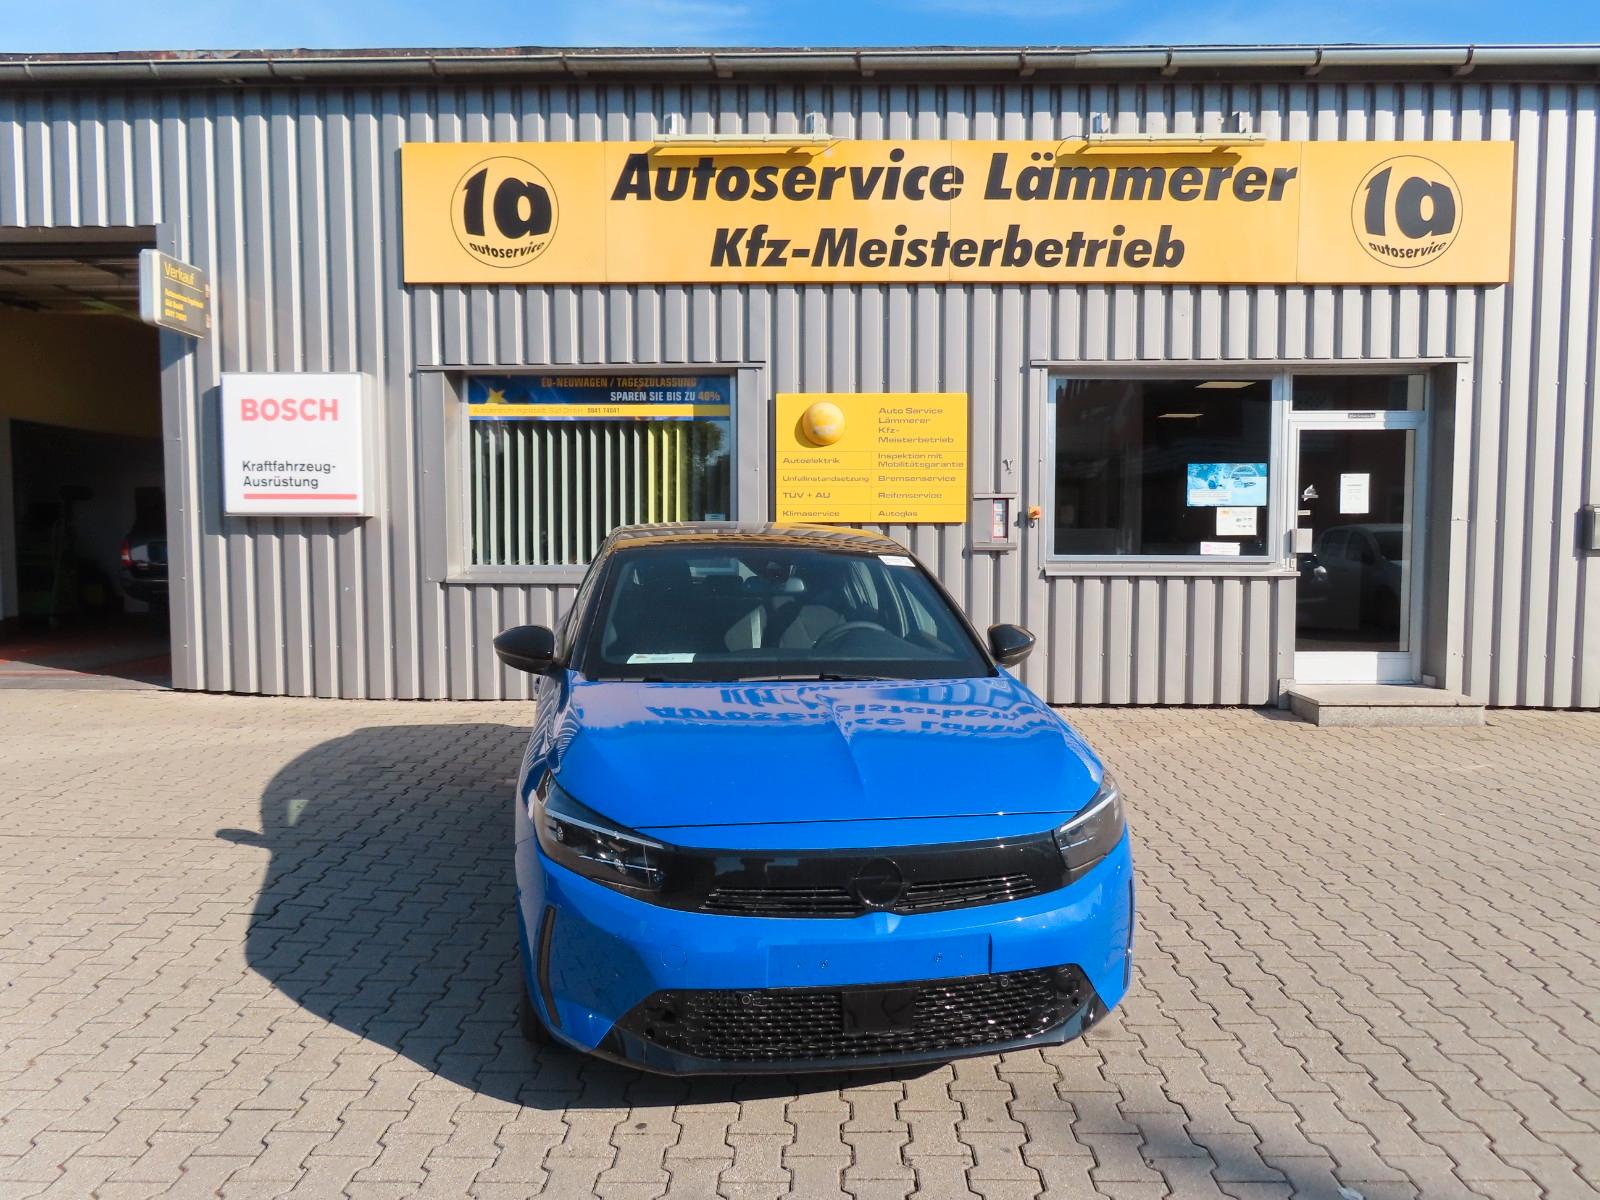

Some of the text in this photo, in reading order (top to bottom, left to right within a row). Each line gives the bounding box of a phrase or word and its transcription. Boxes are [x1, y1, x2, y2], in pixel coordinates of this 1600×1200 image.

[610, 147, 1298, 202] Autoservice Lämmerer
[462, 167, 552, 240] 1a
[1364, 166, 1456, 240] 1a
[468, 241, 545, 259] autoservice
[710, 224, 1186, 269] Kfz-Meisterbetrieb
[1368, 241, 1447, 259] autoservice
[163, 261, 195, 285] Verkauf
[610, 391, 647, 401] SPAREN
[649, 391, 664, 401] SIE
[666, 391, 682, 401] BIS
[684, 391, 696, 401] ZU
[240, 398, 339, 422] BOSCH
[878, 407, 944, 415] Auto Service
[878, 416, 931, 424] Lämmerer
[878, 426, 900, 434] Kfz-
[878, 436, 955, 444] Meisterbetrieb
[782, 457, 841, 465] Autoelektrik
[878, 452, 944, 461] Inspektion mit
[241, 460, 337, 475] Kraftfahrzeug-
[243, 474, 319, 490] Ausrüstung
[782, 475, 870, 483] Unfallinstandsetzung
[878, 475, 957, 483] Bremsenservice
[782, 491, 805, 499] TÜV
[815, 491, 832, 499] AU
[878, 491, 943, 499] Reifenservice
[782, 510, 841, 518] Klimaservice
[878, 510, 918, 518] Autoglas
